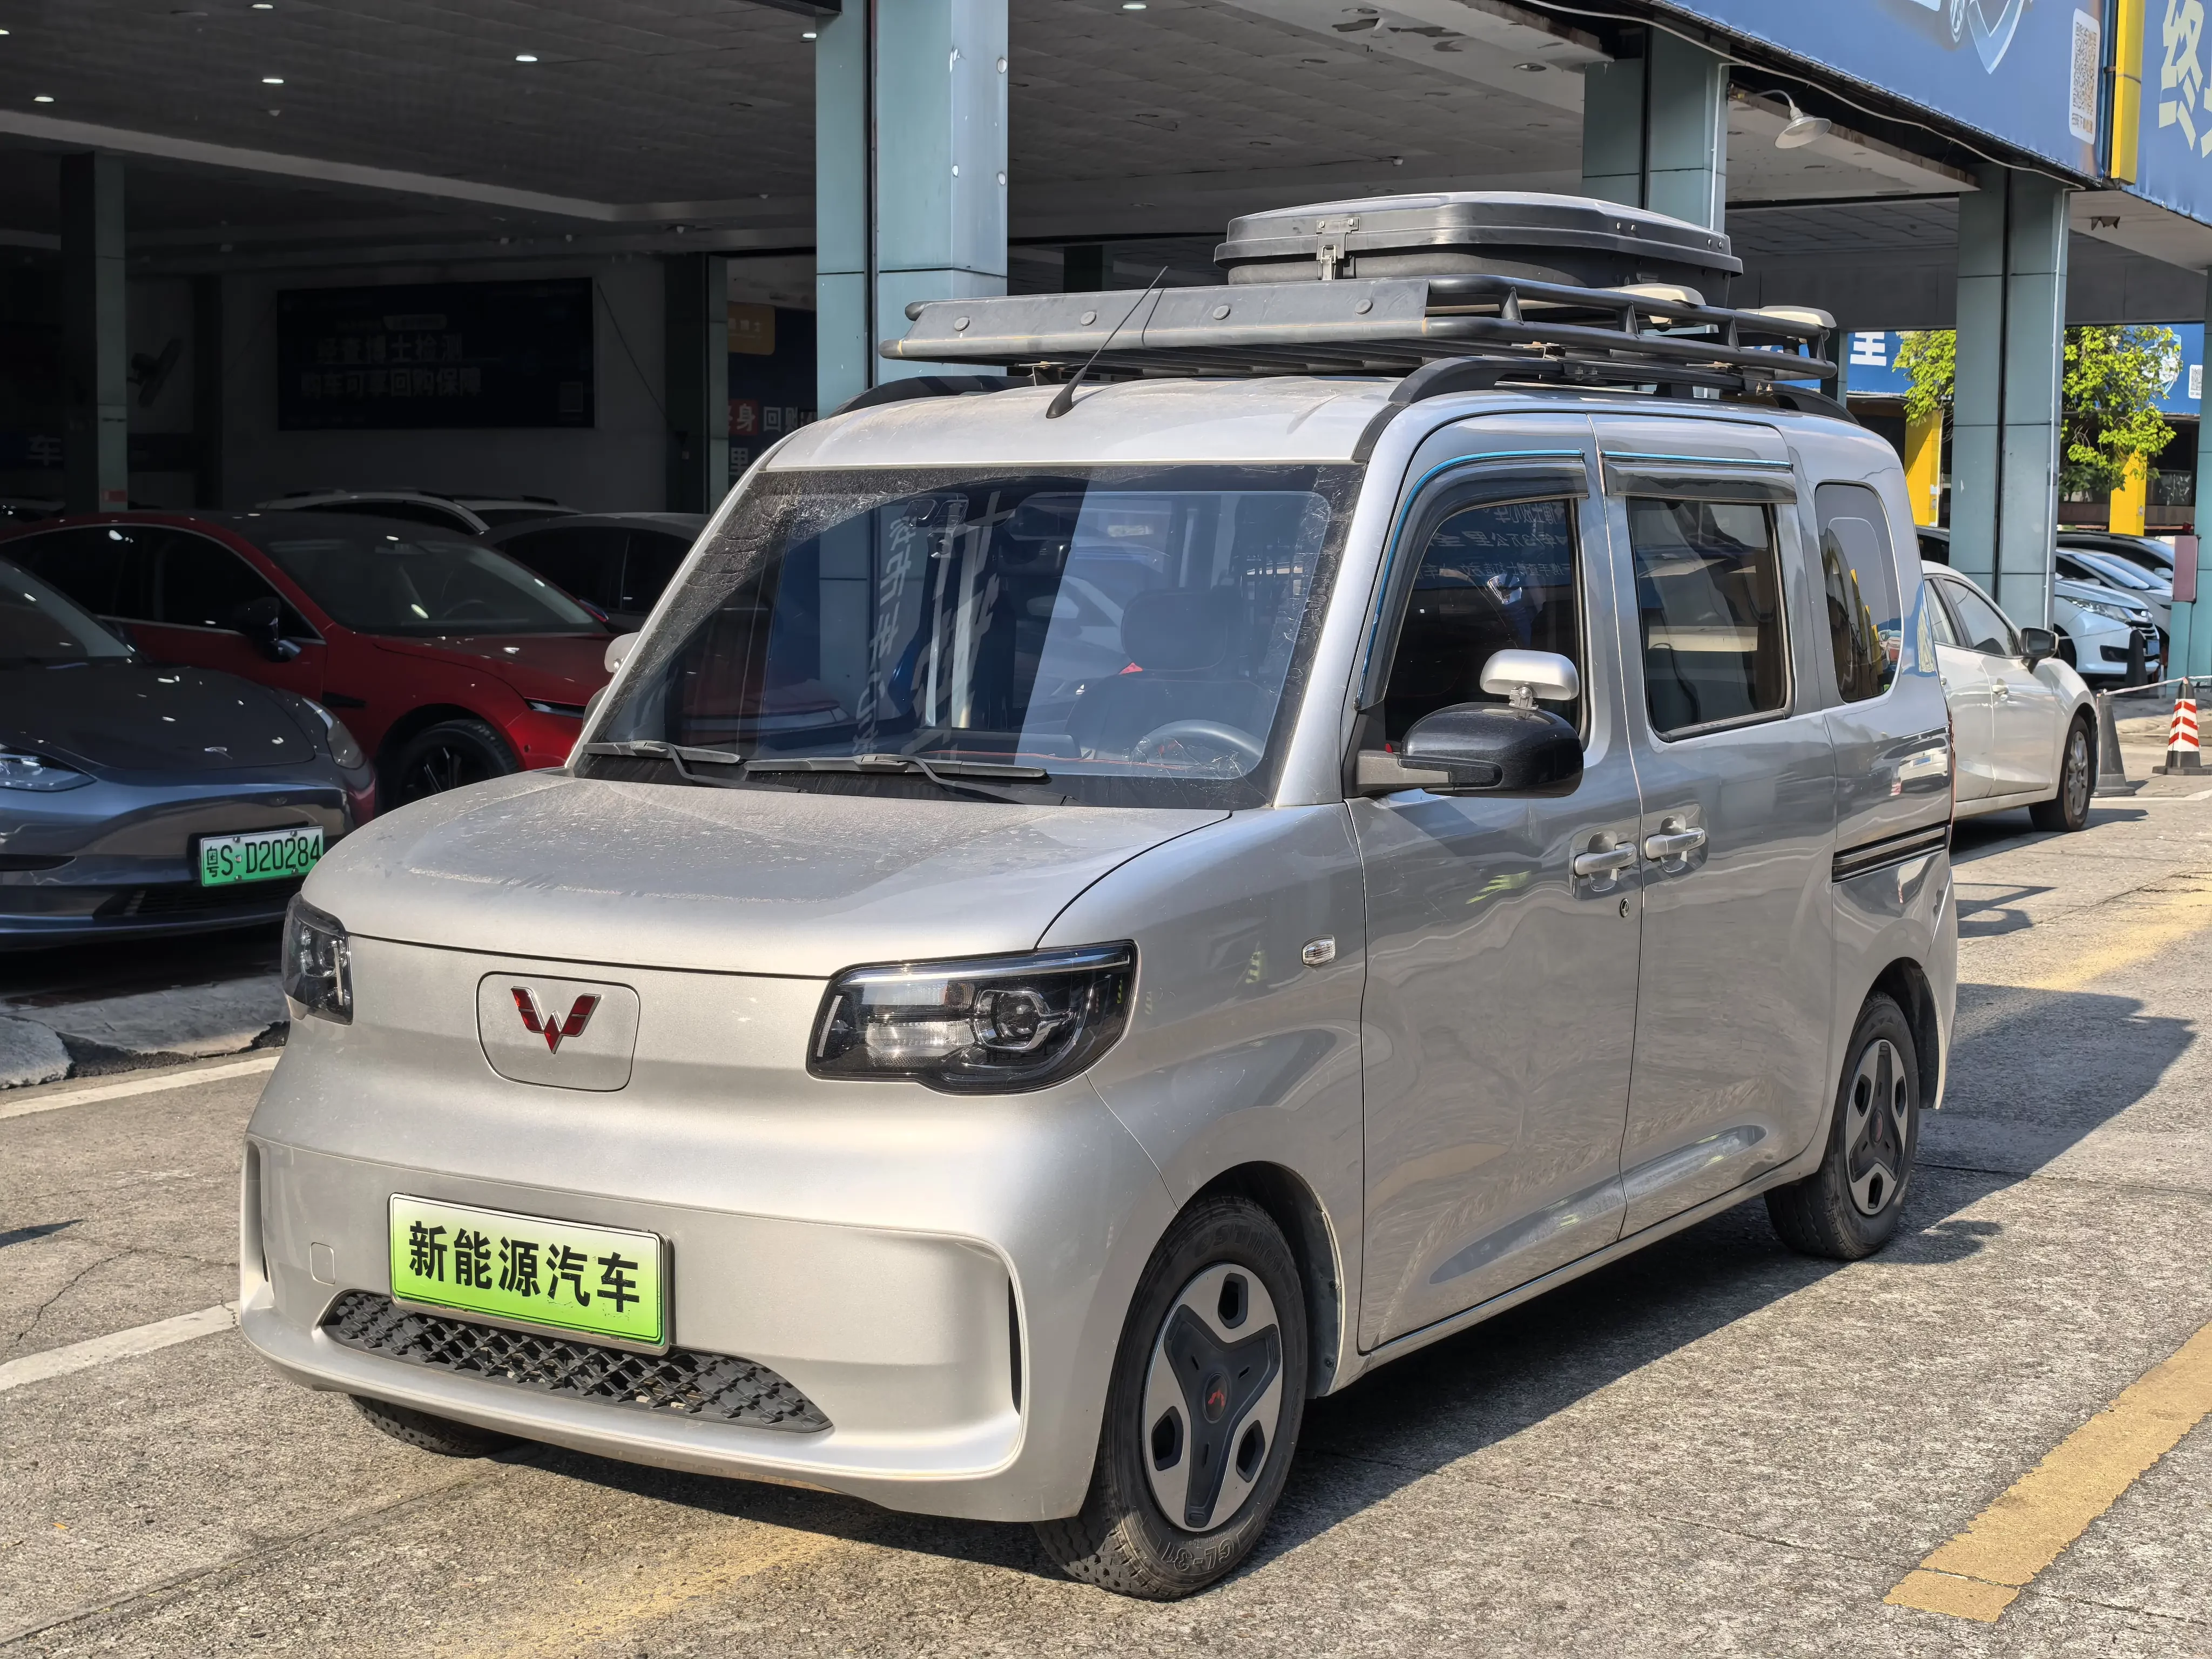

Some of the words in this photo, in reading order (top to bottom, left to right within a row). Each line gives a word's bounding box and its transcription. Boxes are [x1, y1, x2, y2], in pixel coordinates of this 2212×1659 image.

[2159, 0, 2212, 158] 终
[409, 1220, 640, 1313] 新能源汽车
